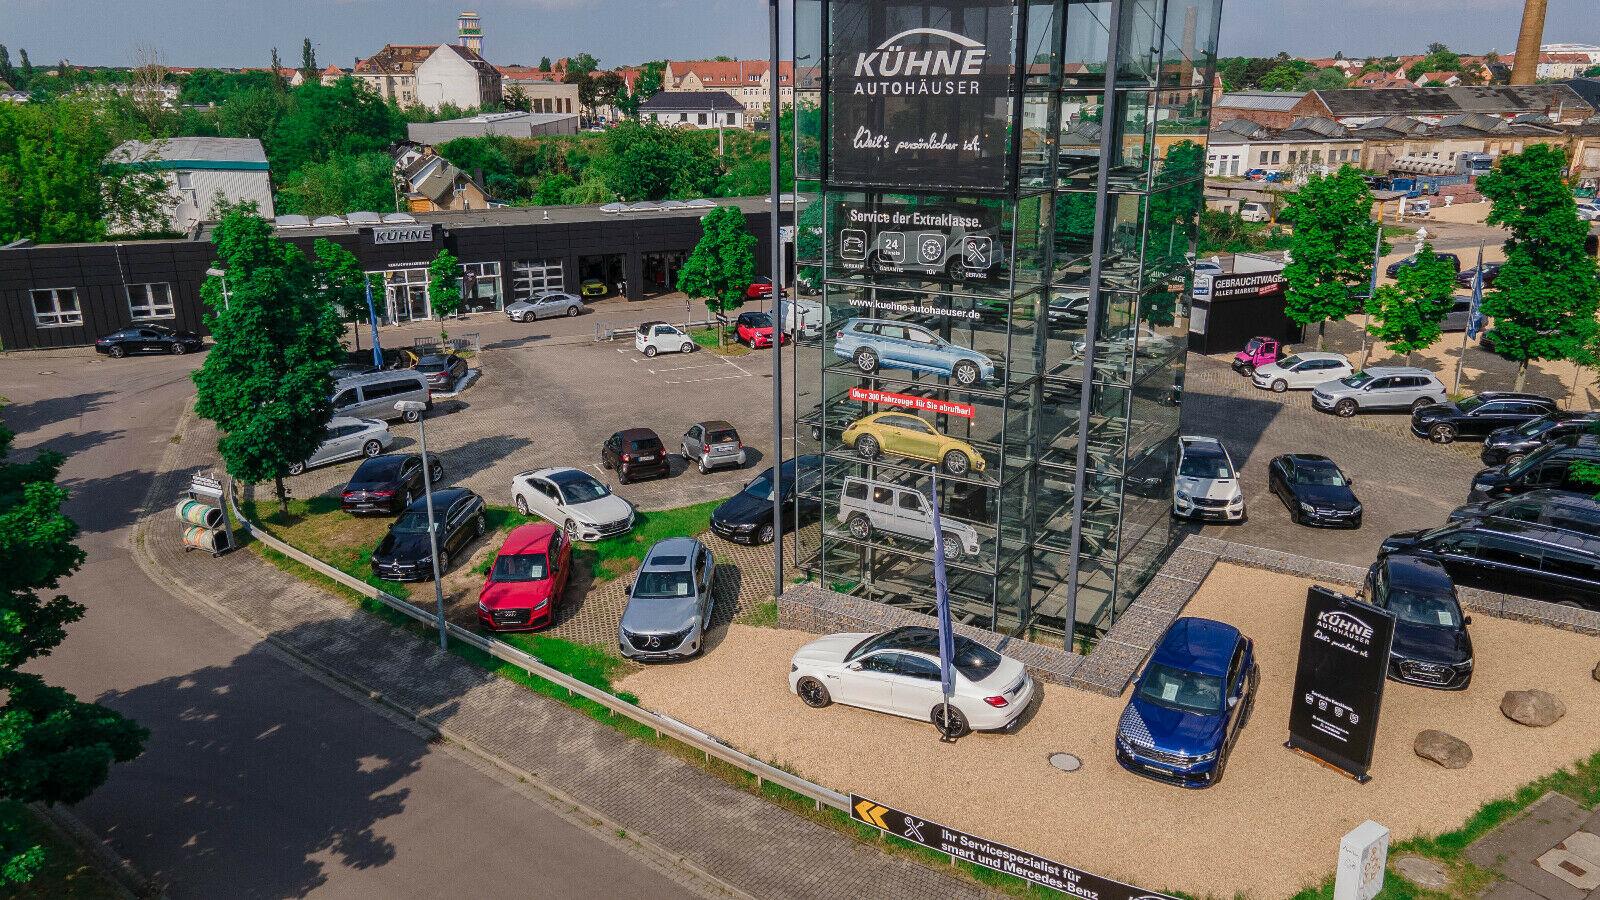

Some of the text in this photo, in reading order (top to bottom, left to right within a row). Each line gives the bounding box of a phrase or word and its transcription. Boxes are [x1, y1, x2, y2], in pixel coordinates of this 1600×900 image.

[854, 45, 987, 77] KÜHNE
[853, 79, 980, 95] AUTOHÄUSER
[895, 132, 959, 153] persönlicher
[850, 209, 982, 228] Service der Extraklasse.
[376, 229, 431, 242] KÜHNE
[885, 239, 898, 250] 24
[965, 271, 987, 279] SERVICE
[1215, 289, 1233, 297] ALLER
[849, 298, 981, 319] www.kuehne-autohaeuser.de
[852, 388, 971, 416] Über 300 Fahrzeuge für Sie abrufbar!
[1316, 621, 1370, 645] AUTOHÄUSER
[1317, 611, 1374, 639] KÜHNE
[941, 829, 1082, 883] Ihr Servicespezialist für
[941, 842, 1099, 900] smart und Mercedes-Benz
